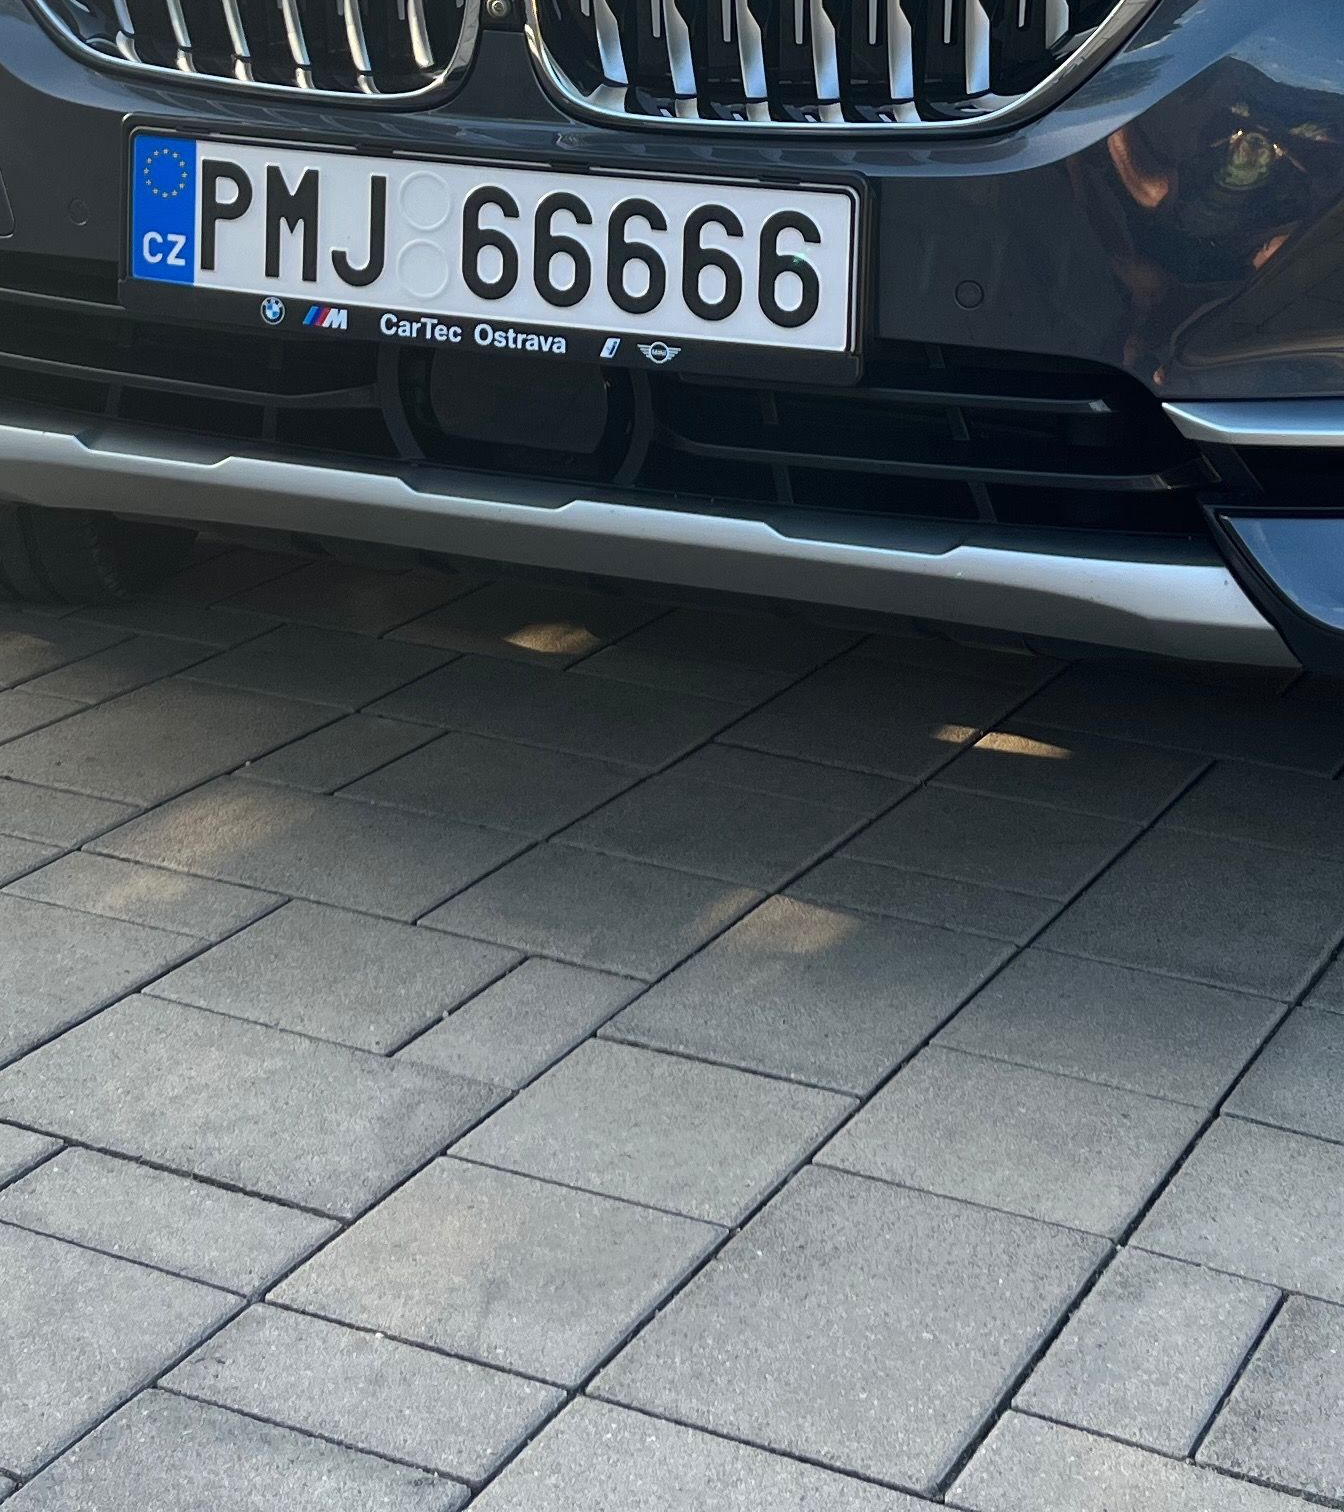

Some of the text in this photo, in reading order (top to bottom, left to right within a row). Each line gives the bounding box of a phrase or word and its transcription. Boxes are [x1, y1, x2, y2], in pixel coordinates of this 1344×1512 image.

[142, 231, 187, 266] CZ
[200, 158, 822, 329] PMJ 66666
[379, 313, 567, 354] CarTec Ostrava
